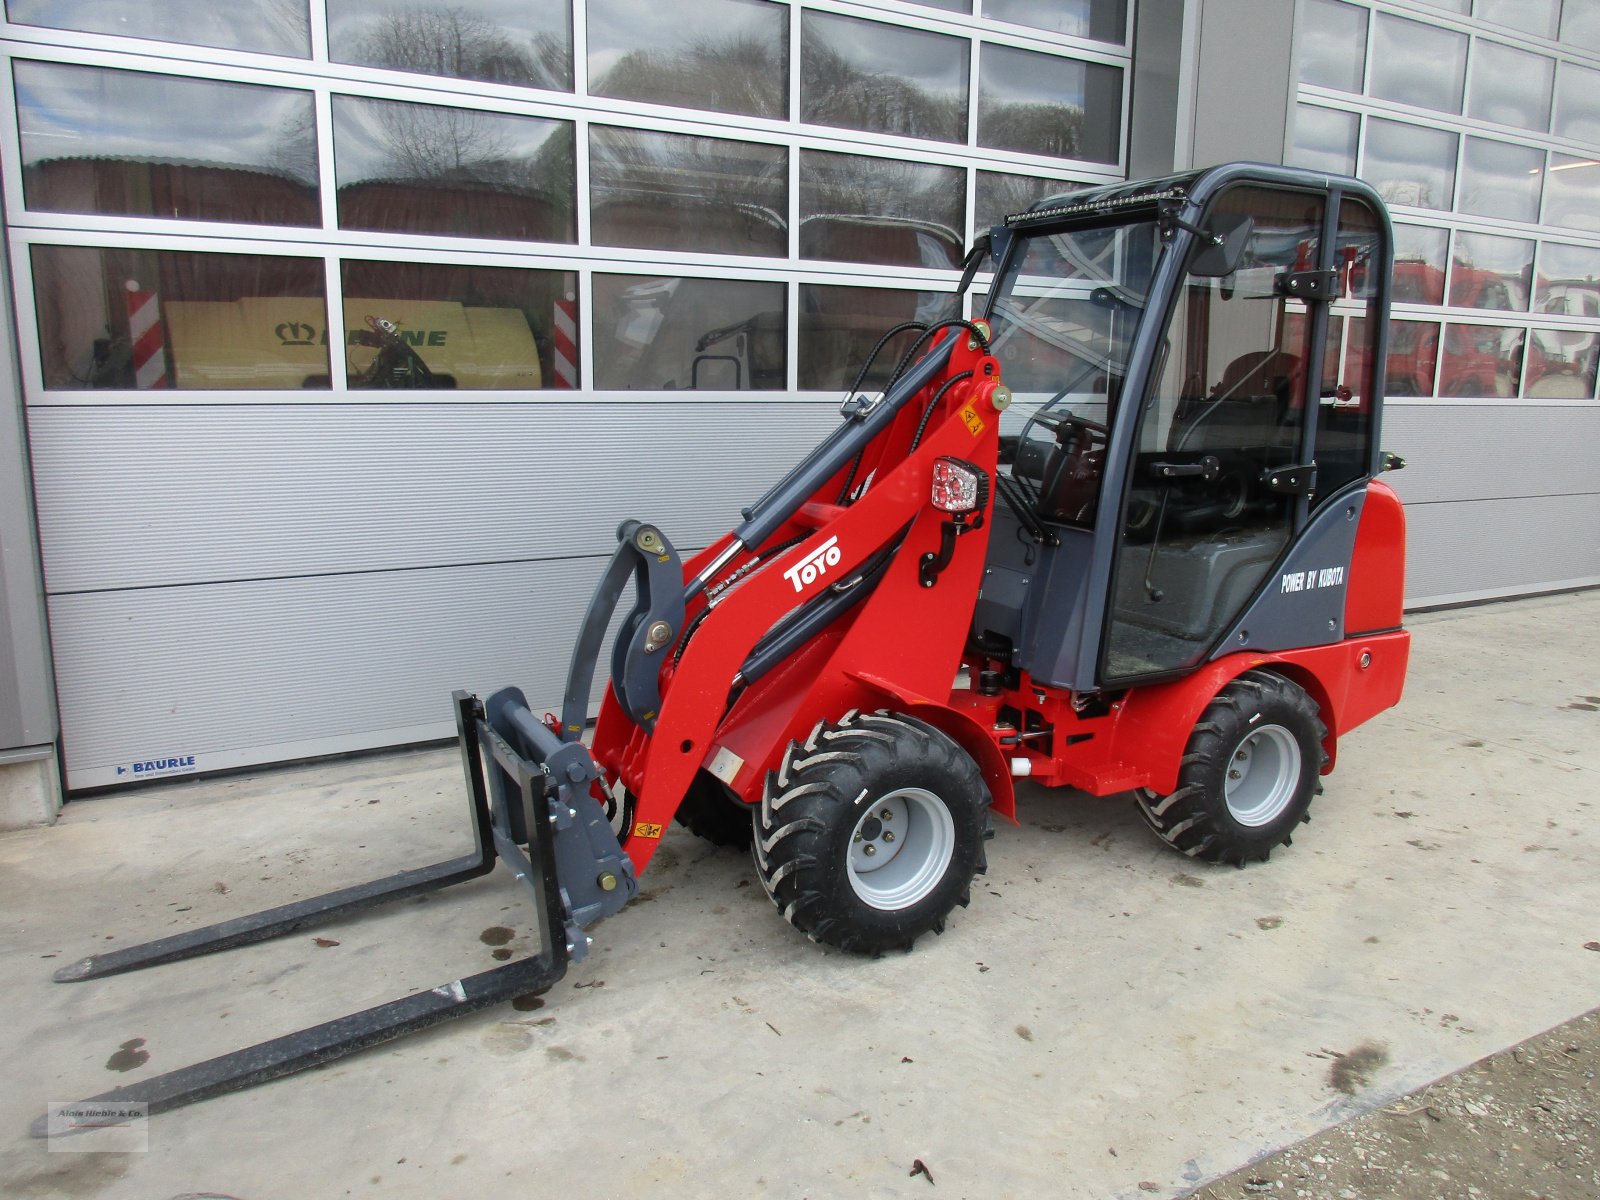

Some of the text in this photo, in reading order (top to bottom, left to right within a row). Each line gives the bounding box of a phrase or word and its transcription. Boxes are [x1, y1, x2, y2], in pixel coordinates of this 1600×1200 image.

[783, 535, 841, 593] TOYO
[1280, 566, 1344, 594] POWER BY KUBOTA
[133, 756, 196, 773] BÄURLE
